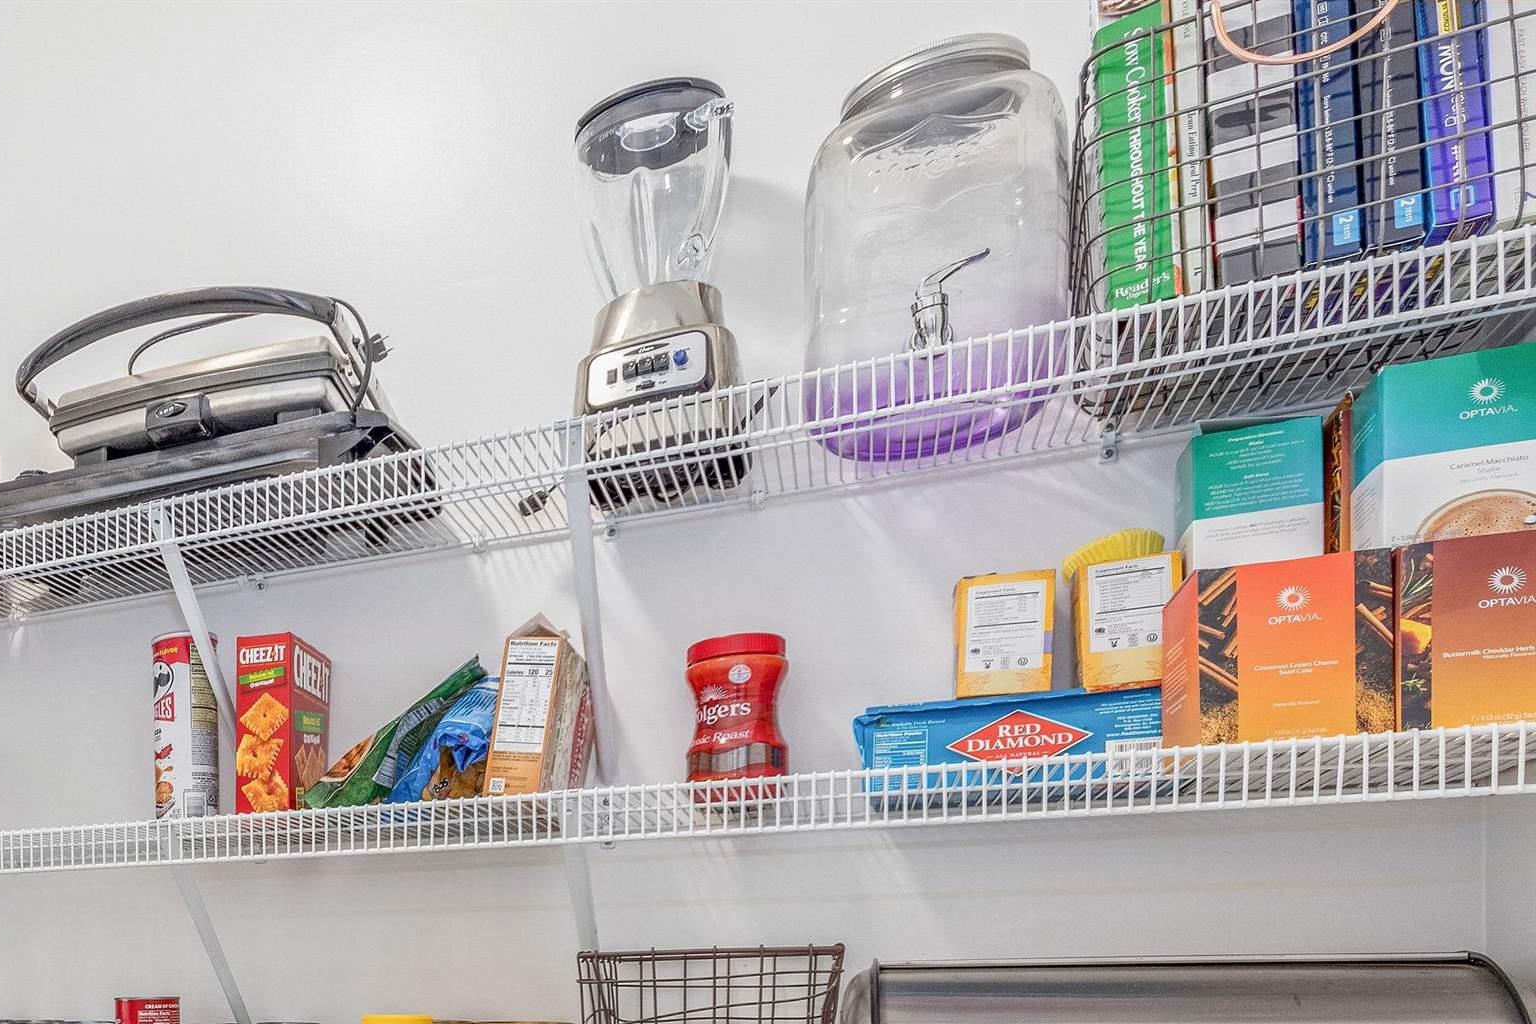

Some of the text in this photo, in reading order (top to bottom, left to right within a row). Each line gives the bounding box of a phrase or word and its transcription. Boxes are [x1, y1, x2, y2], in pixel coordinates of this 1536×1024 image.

[1128, 127, 1146, 210] THROUGHOUT
[1401, 197, 1415, 207] 2
[1131, 211, 1147, 236] THE
[1340, 215, 1354, 225] 2
[1132, 236, 1151, 272] YEAR
[1449, 453, 1529, 471] Caramel Macchiato
[997, 724, 1041, 737] RED
[967, 731, 1073, 752] DIAMOND
